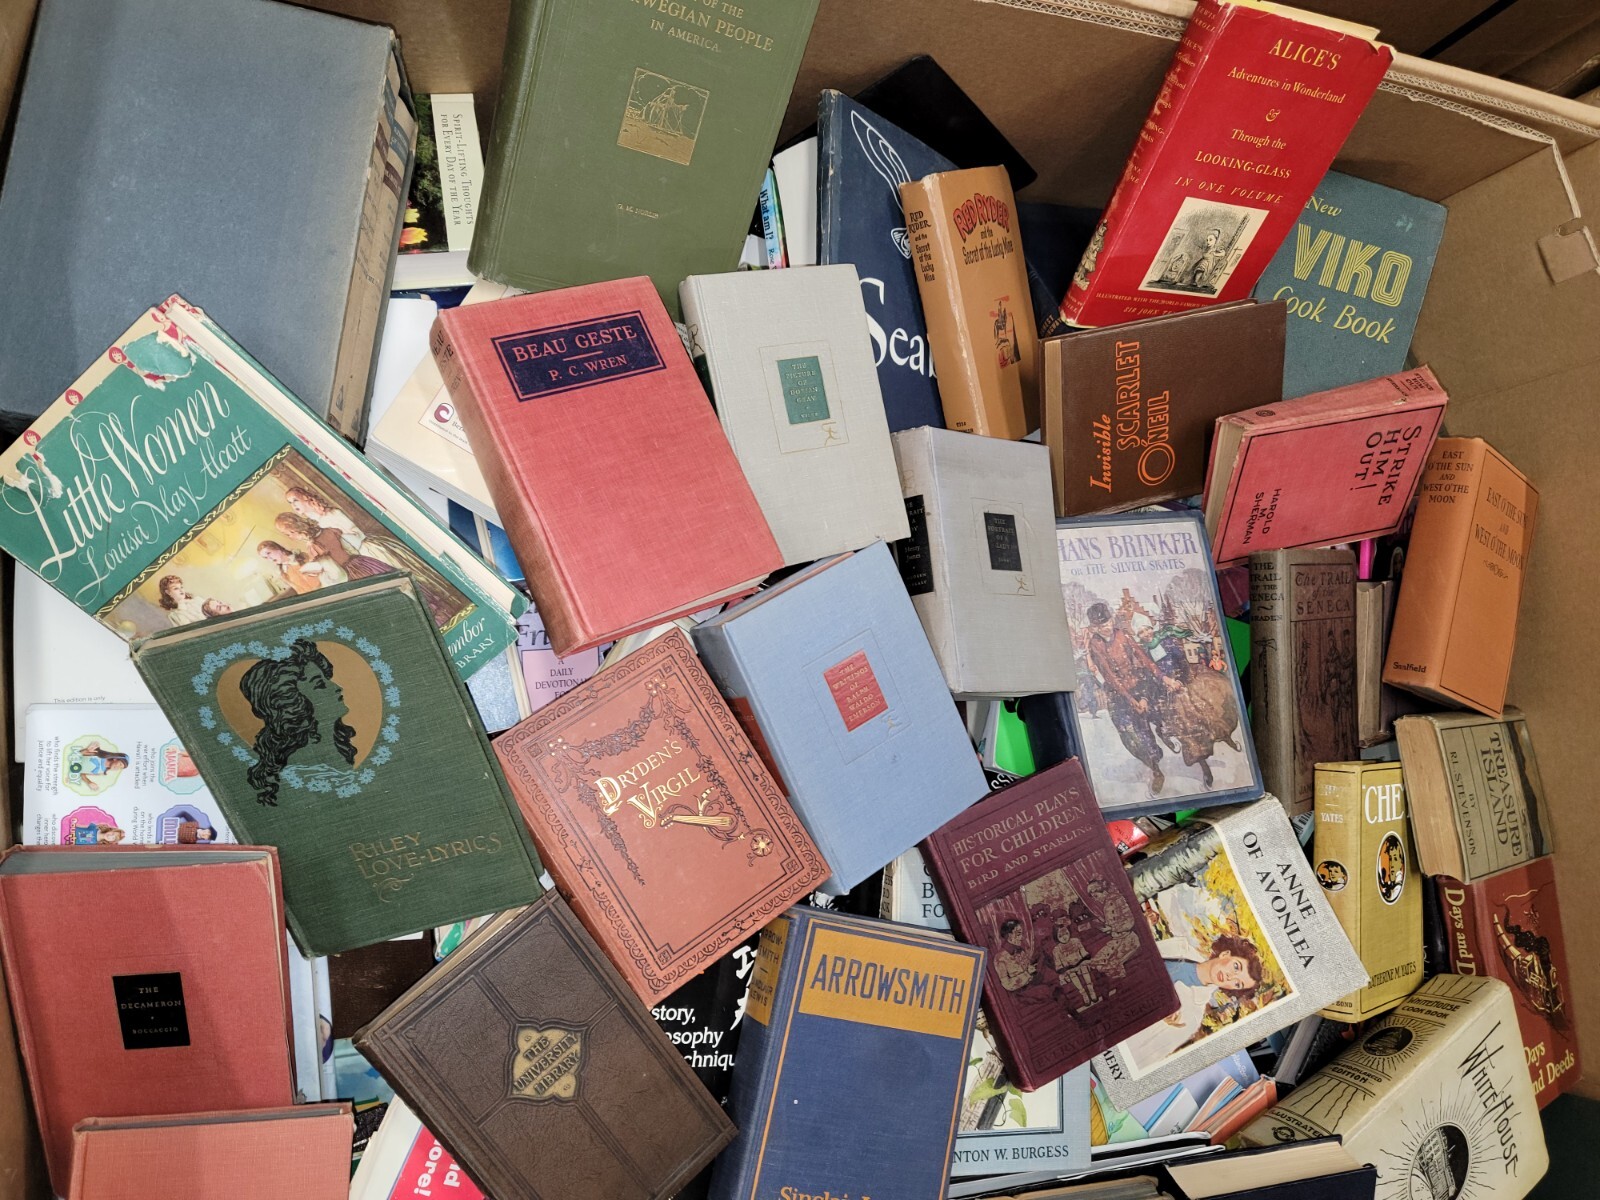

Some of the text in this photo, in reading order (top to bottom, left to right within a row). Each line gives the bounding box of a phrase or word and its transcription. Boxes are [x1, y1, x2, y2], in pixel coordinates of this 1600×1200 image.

[721, 1, 744, 19] THE
[650, 19, 720, 52] IN AMERICA
[714, 18, 774, 52] PEOPLE
[1268, 38, 1342, 72] ALICE'S
[1227, 66, 1346, 105] Adventures in Wonderland
[1265, 108, 1280, 122] &
[1231, 128, 1287, 151] Through the
[1194, 150, 1292, 180] LOOKING-GLASS
[1174, 176, 1284, 205] IN ONE VOLUME
[760, 189, 774, 240] What am I?
[909, 210, 924, 222] RED
[953, 193, 1010, 244] RED RYDER
[1305, 195, 1342, 218] New
[908, 219, 931, 234] RYDER
[916, 243, 931, 254] Secret
[923, 252, 932, 261] the
[962, 237, 1014, 265] Secret the Lucky Mine
[920, 262, 935, 273] Lucky
[923, 273, 936, 282] Mine
[1293, 222, 1413, 308] VIKO
[1273, 286, 1396, 344] Cook Book
[511, 324, 638, 363] BEAU GESTE
[548, 354, 628, 382] P. C. WREN
[791, 362, 807, 370] THE
[1115, 340, 1140, 450] SCARLET
[1090, 414, 1112, 493] Invisible
[1372, 428, 1402, 476] HIM
[1378, 425, 1422, 506] STRIKE
[1442, 450, 1464, 460] EAST
[1439, 473, 1456, 481] AND
[1455, 462, 1474, 472] SUN
[2, 381, 230, 582] Little Women
[1423, 483, 1444, 492] WEST
[1428, 495, 1456, 504] MOON
[1486, 486, 1502, 508] EAST
[75, 425, 252, 606] Louisa May Alcott
[1243, 491, 1265, 545] SHERMAN
[1256, 507, 1267, 522] M.
[1262, 488, 1282, 535] HAROLD
[1057, 532, 1198, 562] HANS BRINKER
[1475, 523, 1491, 548] WEST
[1086, 563, 1107, 575] THE
[1111, 560, 1147, 574] SILVER
[1149, 558, 1186, 571] SKATES
[1250, 572, 1282, 582] TRAIL
[1253, 562, 1275, 571] THE
[1295, 571, 1351, 587] The TRAIL
[1296, 600, 1350, 615] SENECA
[457, 634, 496, 671] BRARY
[550, 667, 574, 678] DAILY
[839, 663, 855, 675] THE
[846, 685, 869, 703] RALPH
[849, 681, 859, 691] OF
[848, 699, 881, 722] EMERSON
[849, 693, 874, 711] WALDO
[68, 745, 83, 786] MELODY
[593, 739, 683, 816] DRYDEN'S
[627, 767, 701, 829] VIRGIL
[1469, 793, 1477, 810] BY
[1480, 749, 1509, 845] ISLAND
[1490, 731, 1523, 857] TREASURE
[952, 786, 1080, 857] HISTORICAL PLAYS
[1321, 812, 1344, 824] YATES
[348, 831, 421, 862] RILEY
[959, 846, 999, 875] FOR
[1001, 804, 1086, 853] CHILDREN
[358, 832, 502, 880] LOVE-LYRICS
[967, 869, 999, 890] BIRD
[1004, 854, 1029, 873] AND
[1033, 823, 1093, 858] STARLING
[1242, 831, 1315, 970] OF AVONLEA
[1276, 862, 1317, 921] ANNE
[1444, 887, 1474, 958] Days and
[758, 944, 780, 965] SMITH
[1401, 961, 1417, 977] YATES
[138, 986, 159, 994] THE
[809, 953, 966, 1015] ARROWSMITH
[120, 1000, 182, 1009] DECAMERON
[651, 1005, 696, 1026] story,
[1401, 1005, 1450, 1019] COOK BOOK
[513, 1032, 578, 1091] UNIVERSITY
[523, 1035, 551, 1061] THE
[1523, 1040, 1545, 1067] Days
[533, 1050, 581, 1095] LIBRARY
[1331, 1066, 1369, 1084] EDITION
[1548, 1050, 1575, 1080] Deeds
[1457, 1020, 1522, 1178] WHITE HOUSE
[995, 1149, 1008, 1161] W.
[1011, 1145, 1070, 1160] BURGESS
